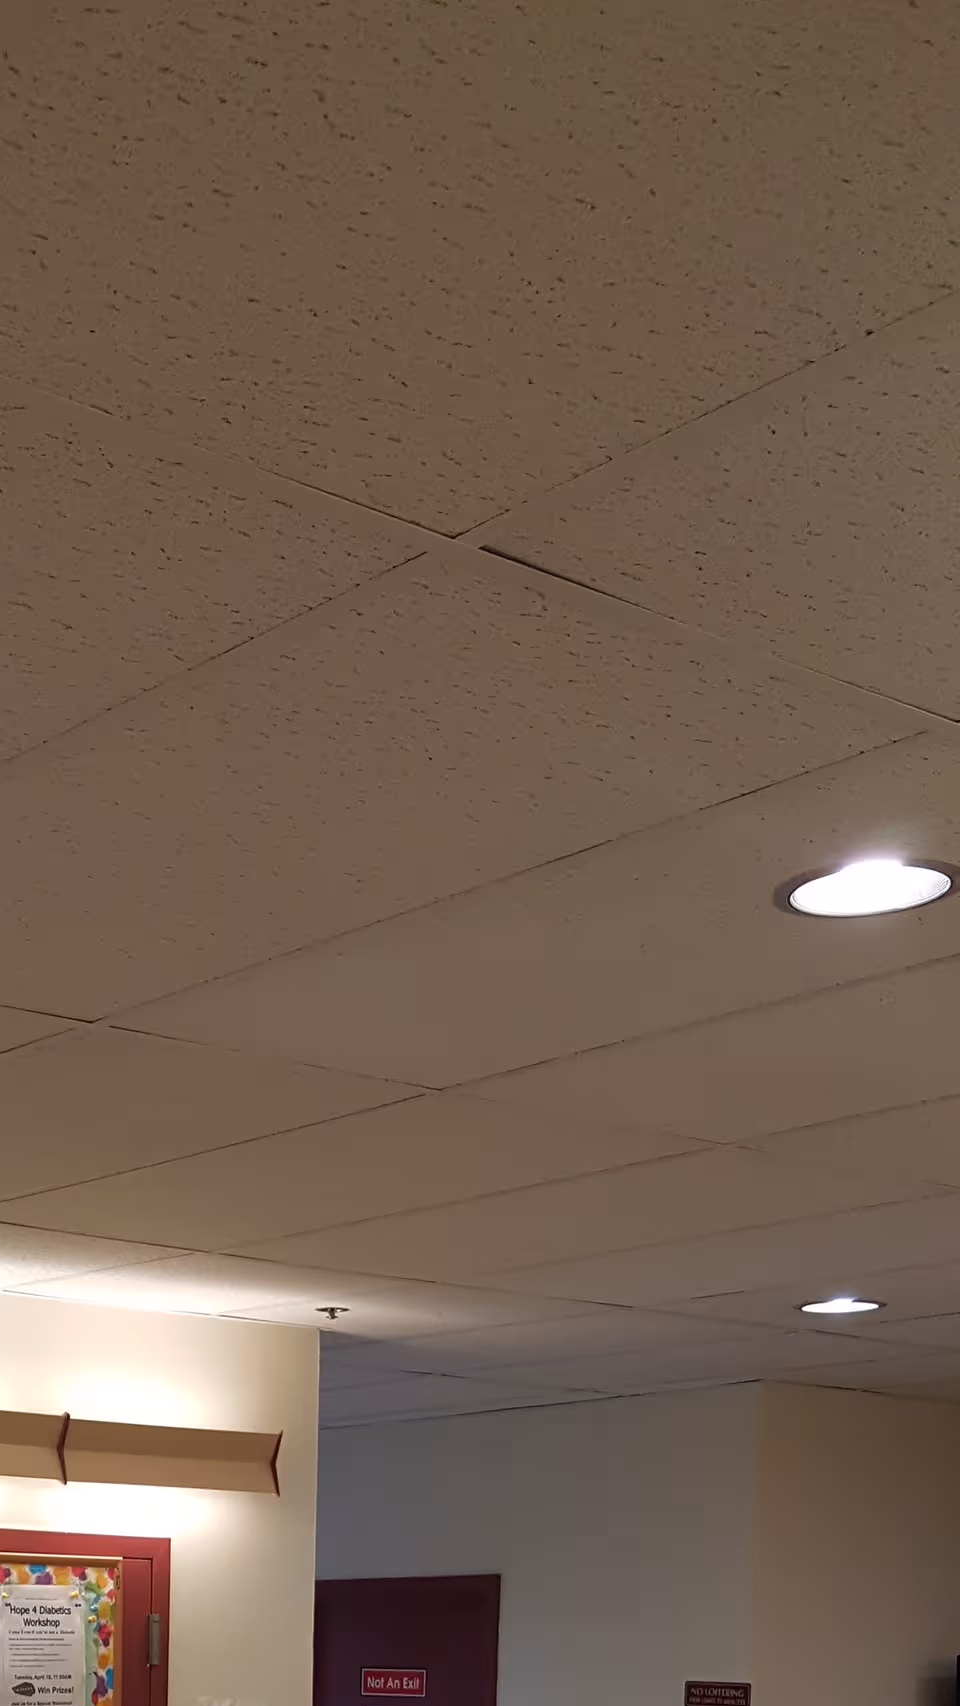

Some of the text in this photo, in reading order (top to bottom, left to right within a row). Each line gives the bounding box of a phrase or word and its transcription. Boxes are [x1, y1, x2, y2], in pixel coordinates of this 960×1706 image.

[32, 1605, 37, 1614] 4
[23, 1617, 60, 1629] Workshop
[367, 1677, 420, 1690] Not An Exit
[38, 1686, 74, 1694] Win Prizes!
[691, 1687, 744, 1697] NO LOITERING
